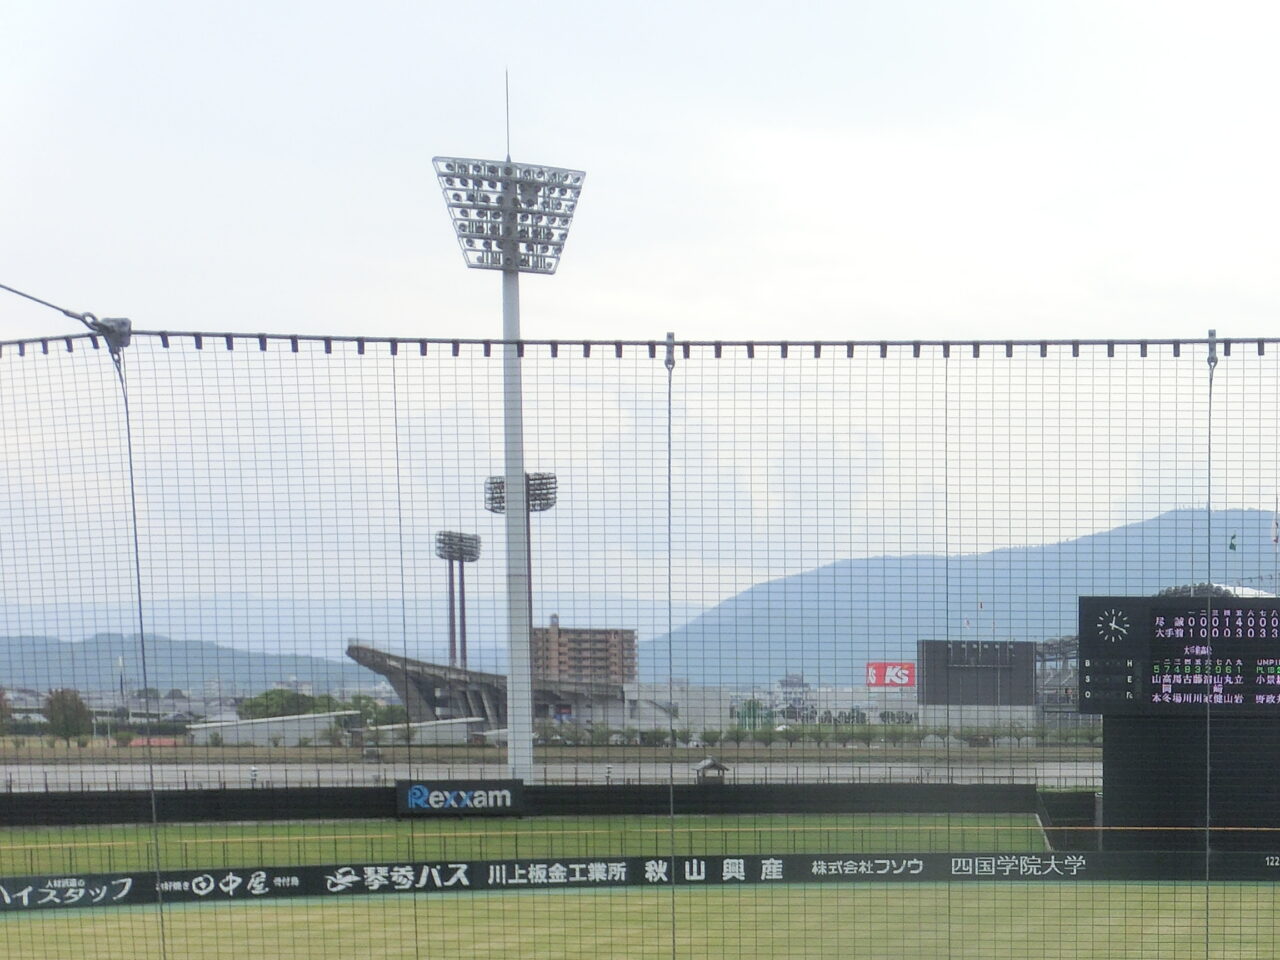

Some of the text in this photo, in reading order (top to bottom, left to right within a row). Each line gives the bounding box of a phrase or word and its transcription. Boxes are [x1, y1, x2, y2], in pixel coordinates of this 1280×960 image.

[1155, 628, 1184, 638] 大手前
[408, 784, 511, 808] Rexxam
[644, 858, 784, 883] 秋山興産
[812, 859, 924, 876] 株式会社フソウ
[952, 855, 1086, 876] 四国学院大学
[1265, 856, 1280, 867] 122
[192, 870, 270, 896] 田中屋
[362, 863, 470, 890] 琴参バス
[488, 862, 628, 886] 川上板金工業所
